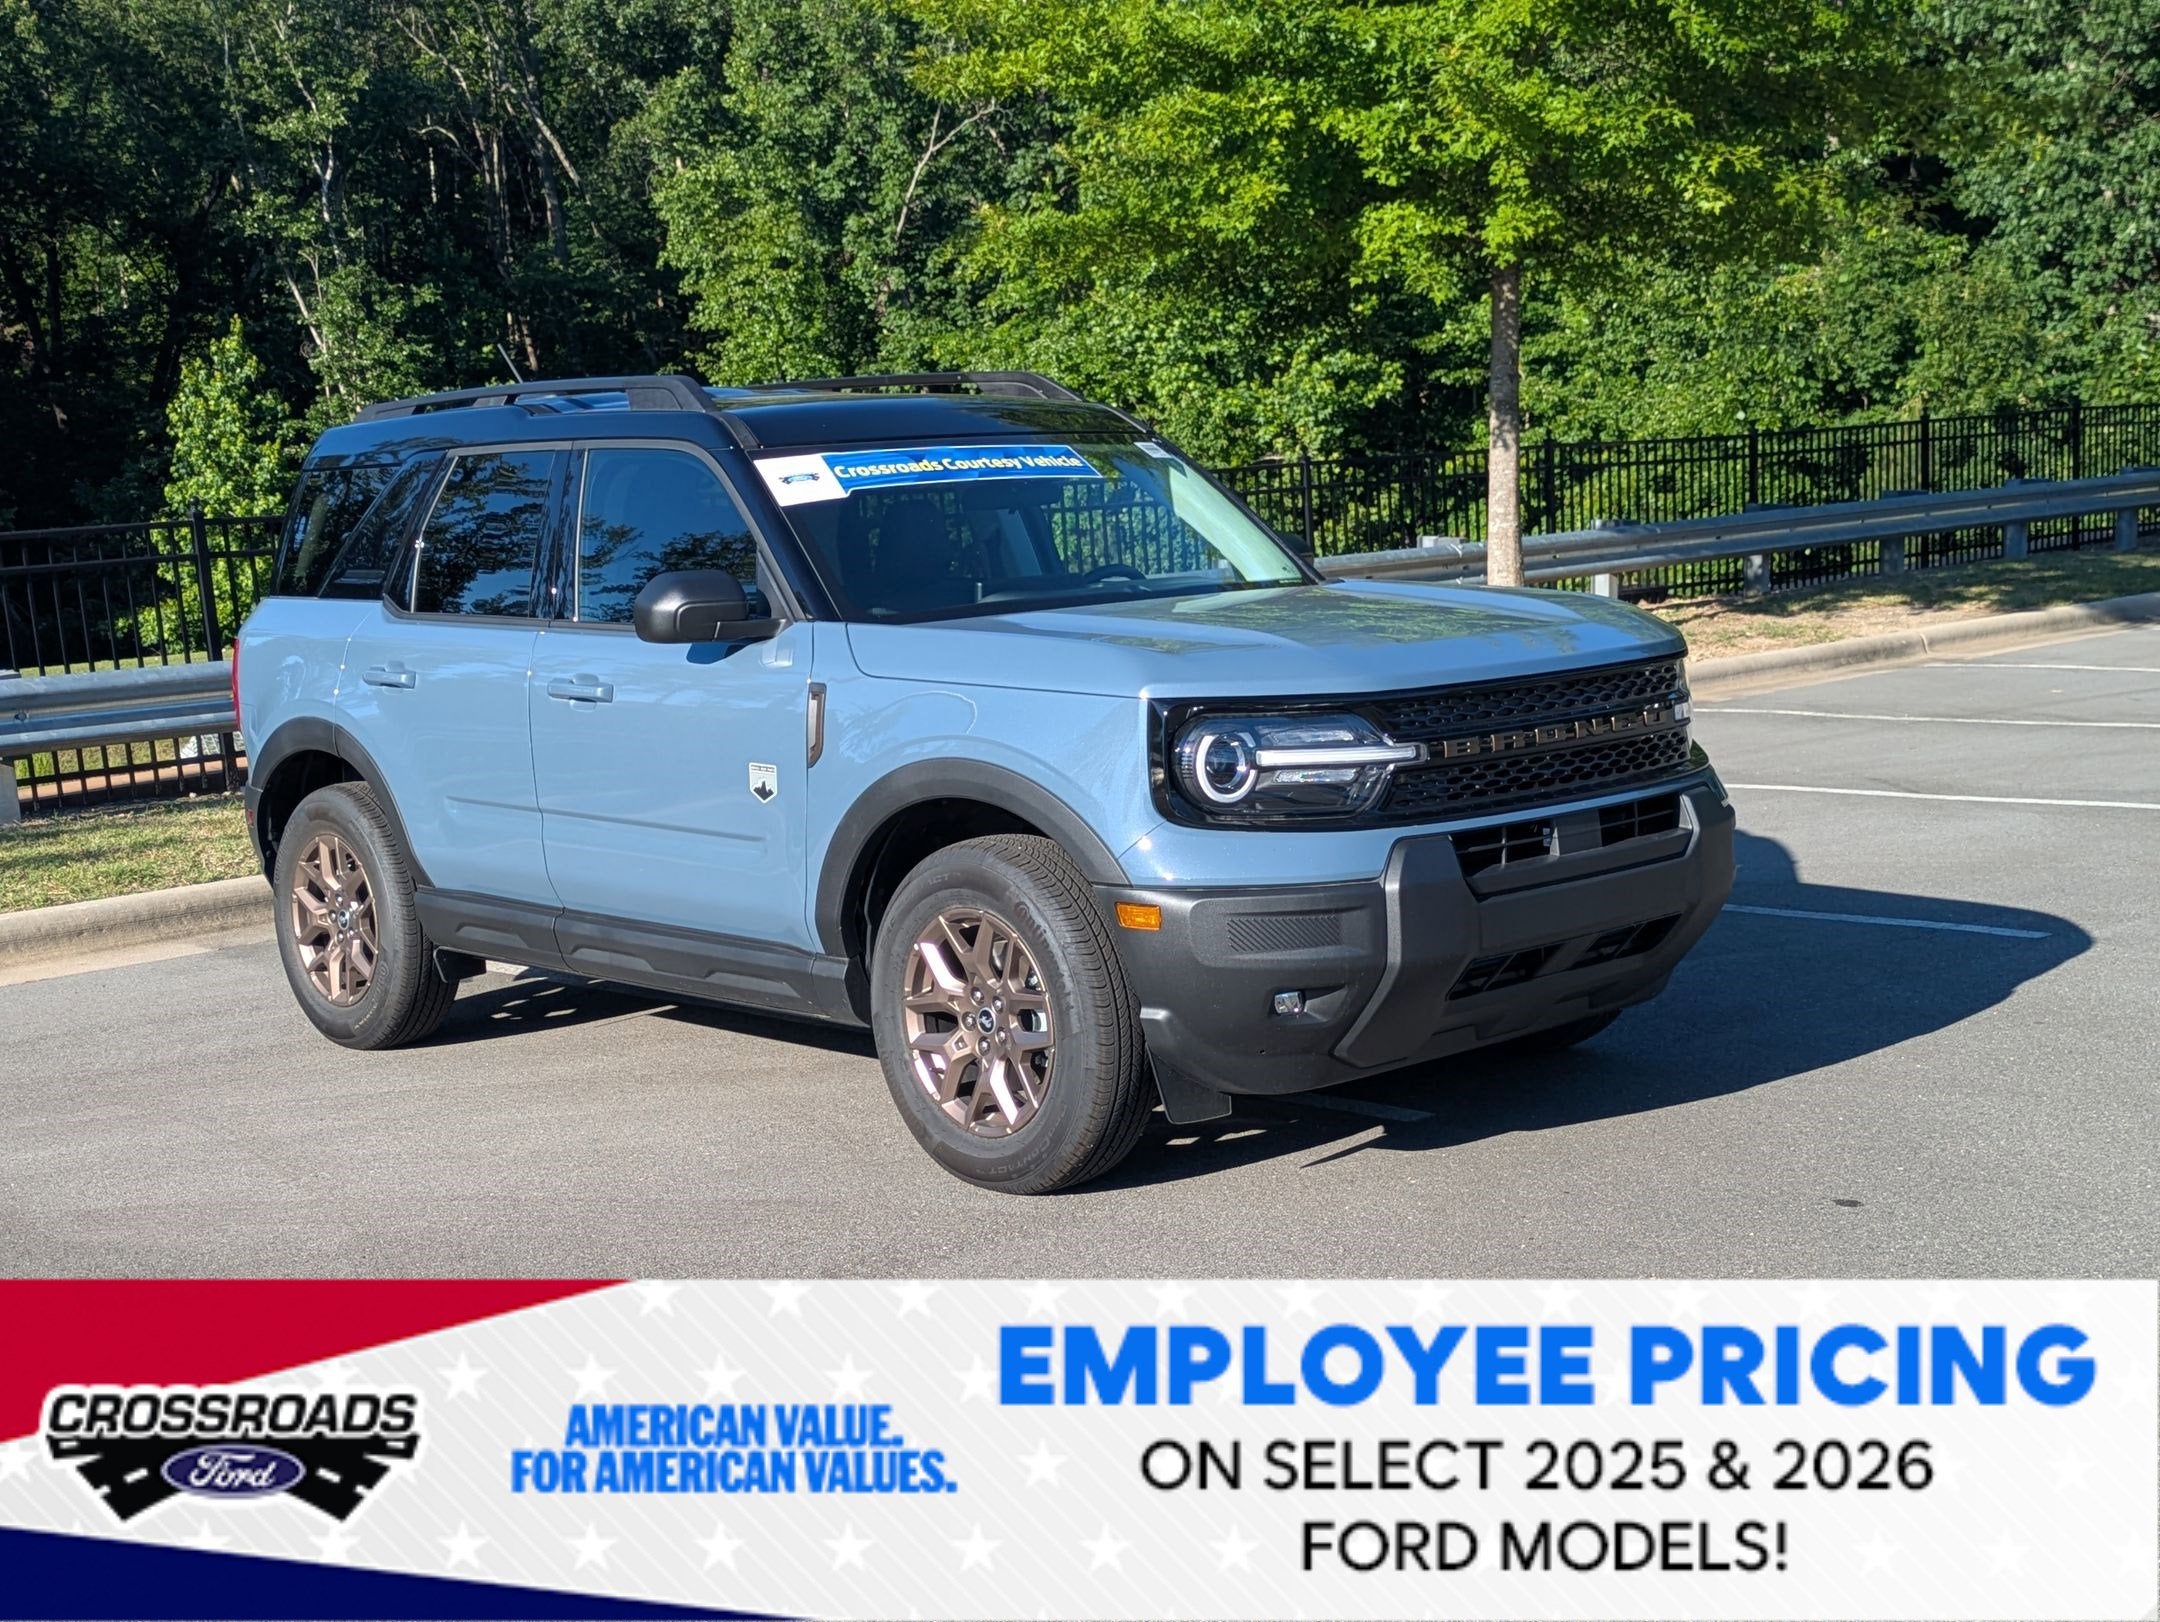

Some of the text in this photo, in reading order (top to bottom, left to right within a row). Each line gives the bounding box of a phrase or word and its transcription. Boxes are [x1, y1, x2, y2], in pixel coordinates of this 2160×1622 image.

[834, 459, 944, 478] Crossroads
[941, 457, 1022, 470] Courtesy
[1018, 455, 1083, 467] Vehicle
[1443, 709, 1673, 759] BRONCO
